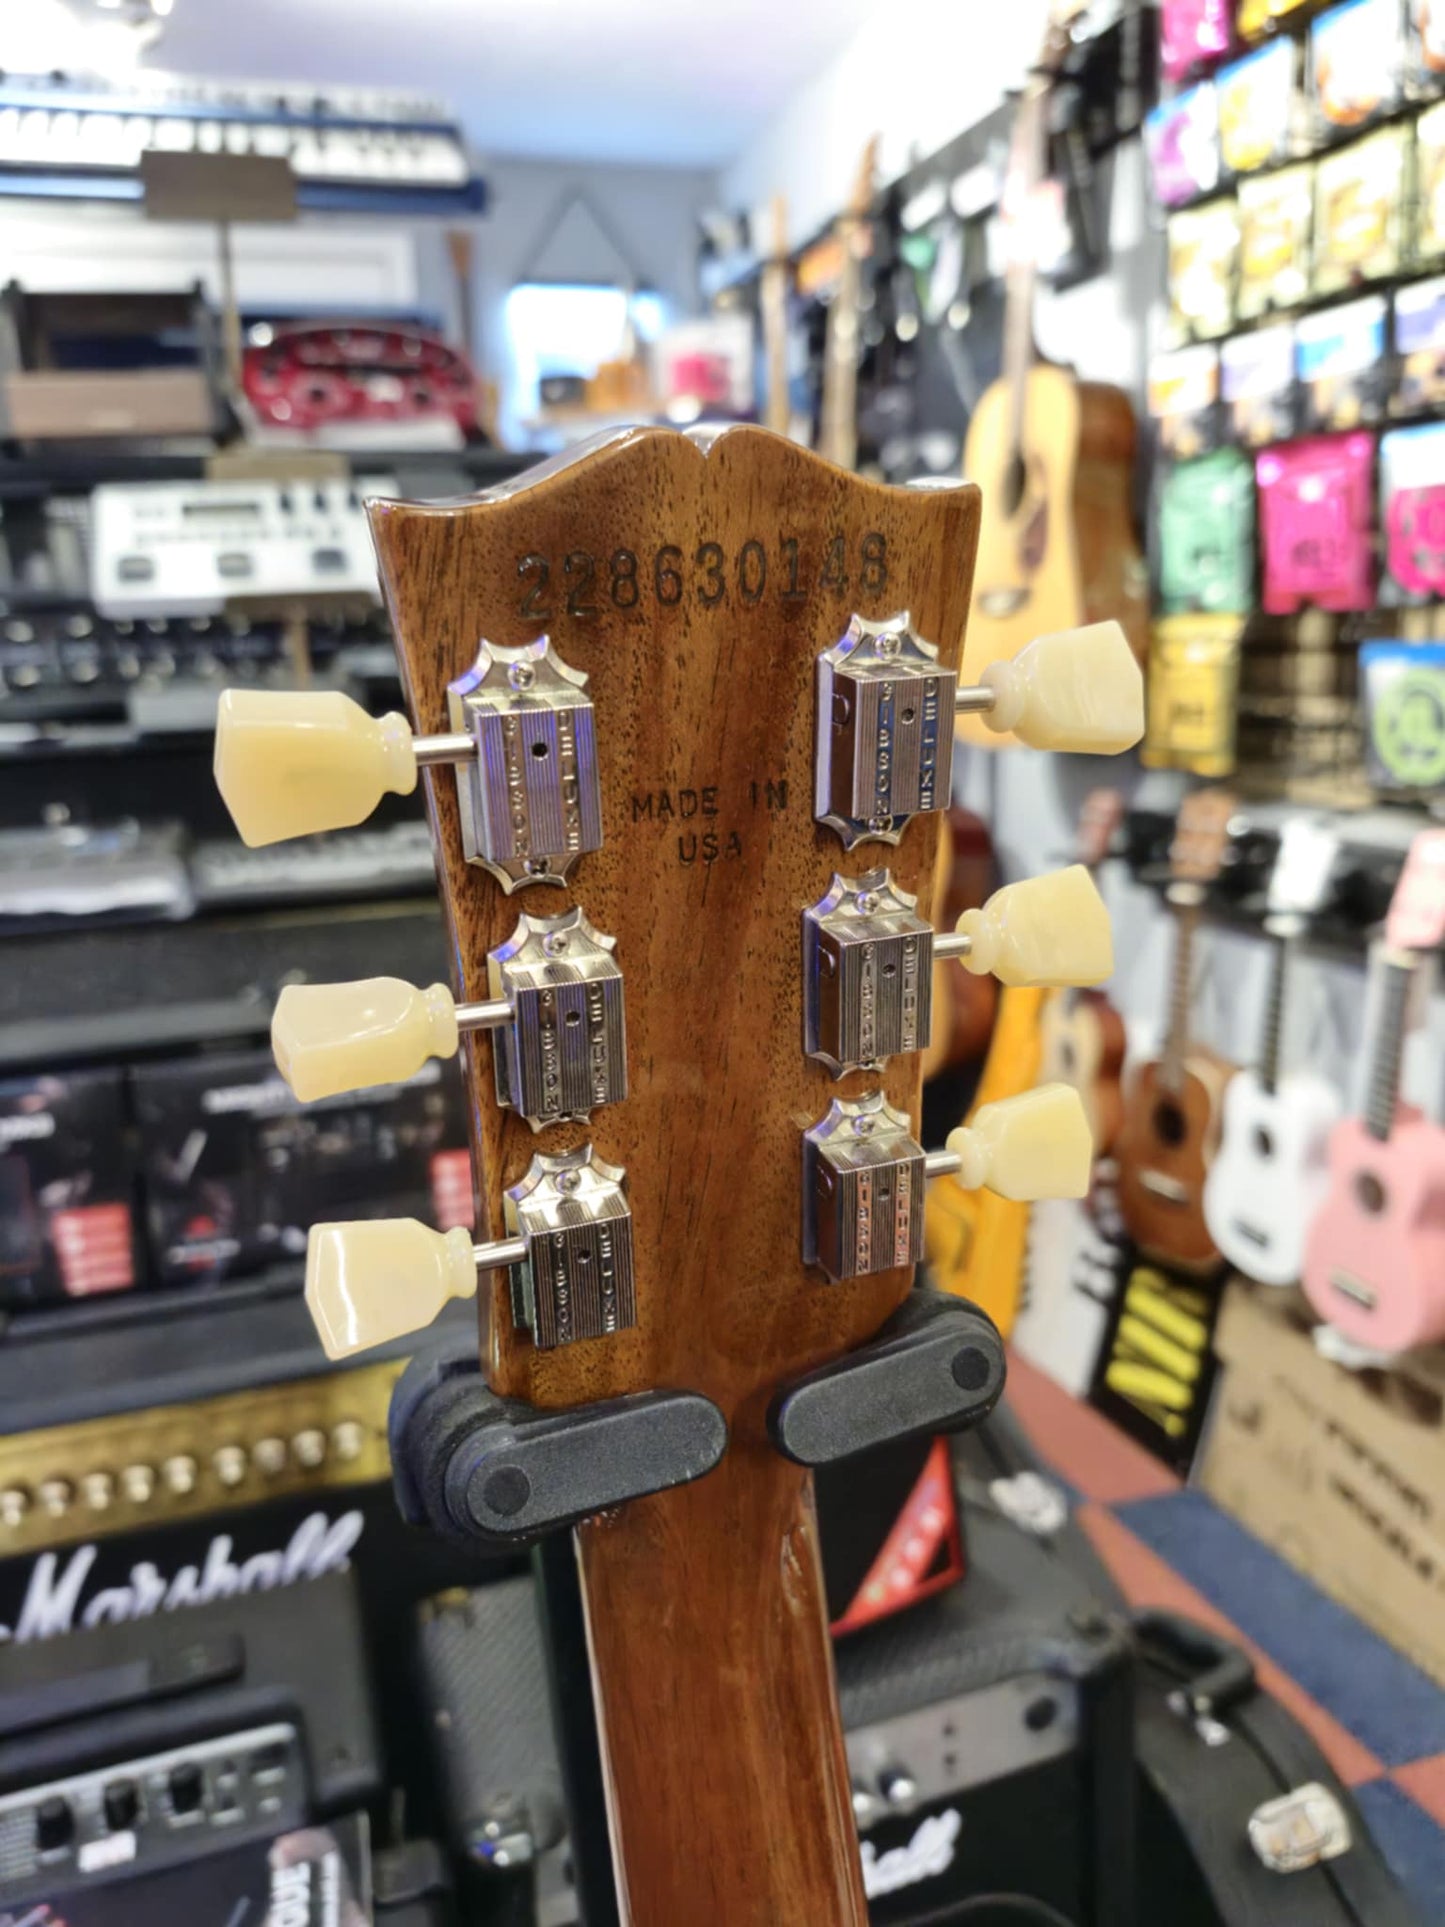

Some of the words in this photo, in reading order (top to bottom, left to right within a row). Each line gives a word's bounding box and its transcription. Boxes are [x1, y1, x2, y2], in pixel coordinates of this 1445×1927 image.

[516, 531, 888, 619] 228630148
[631, 786, 719, 823] MADE
[750, 779, 788, 811] IN
[678, 831, 742, 863] USA
[0, 1510, 365, 1645] Marshall
